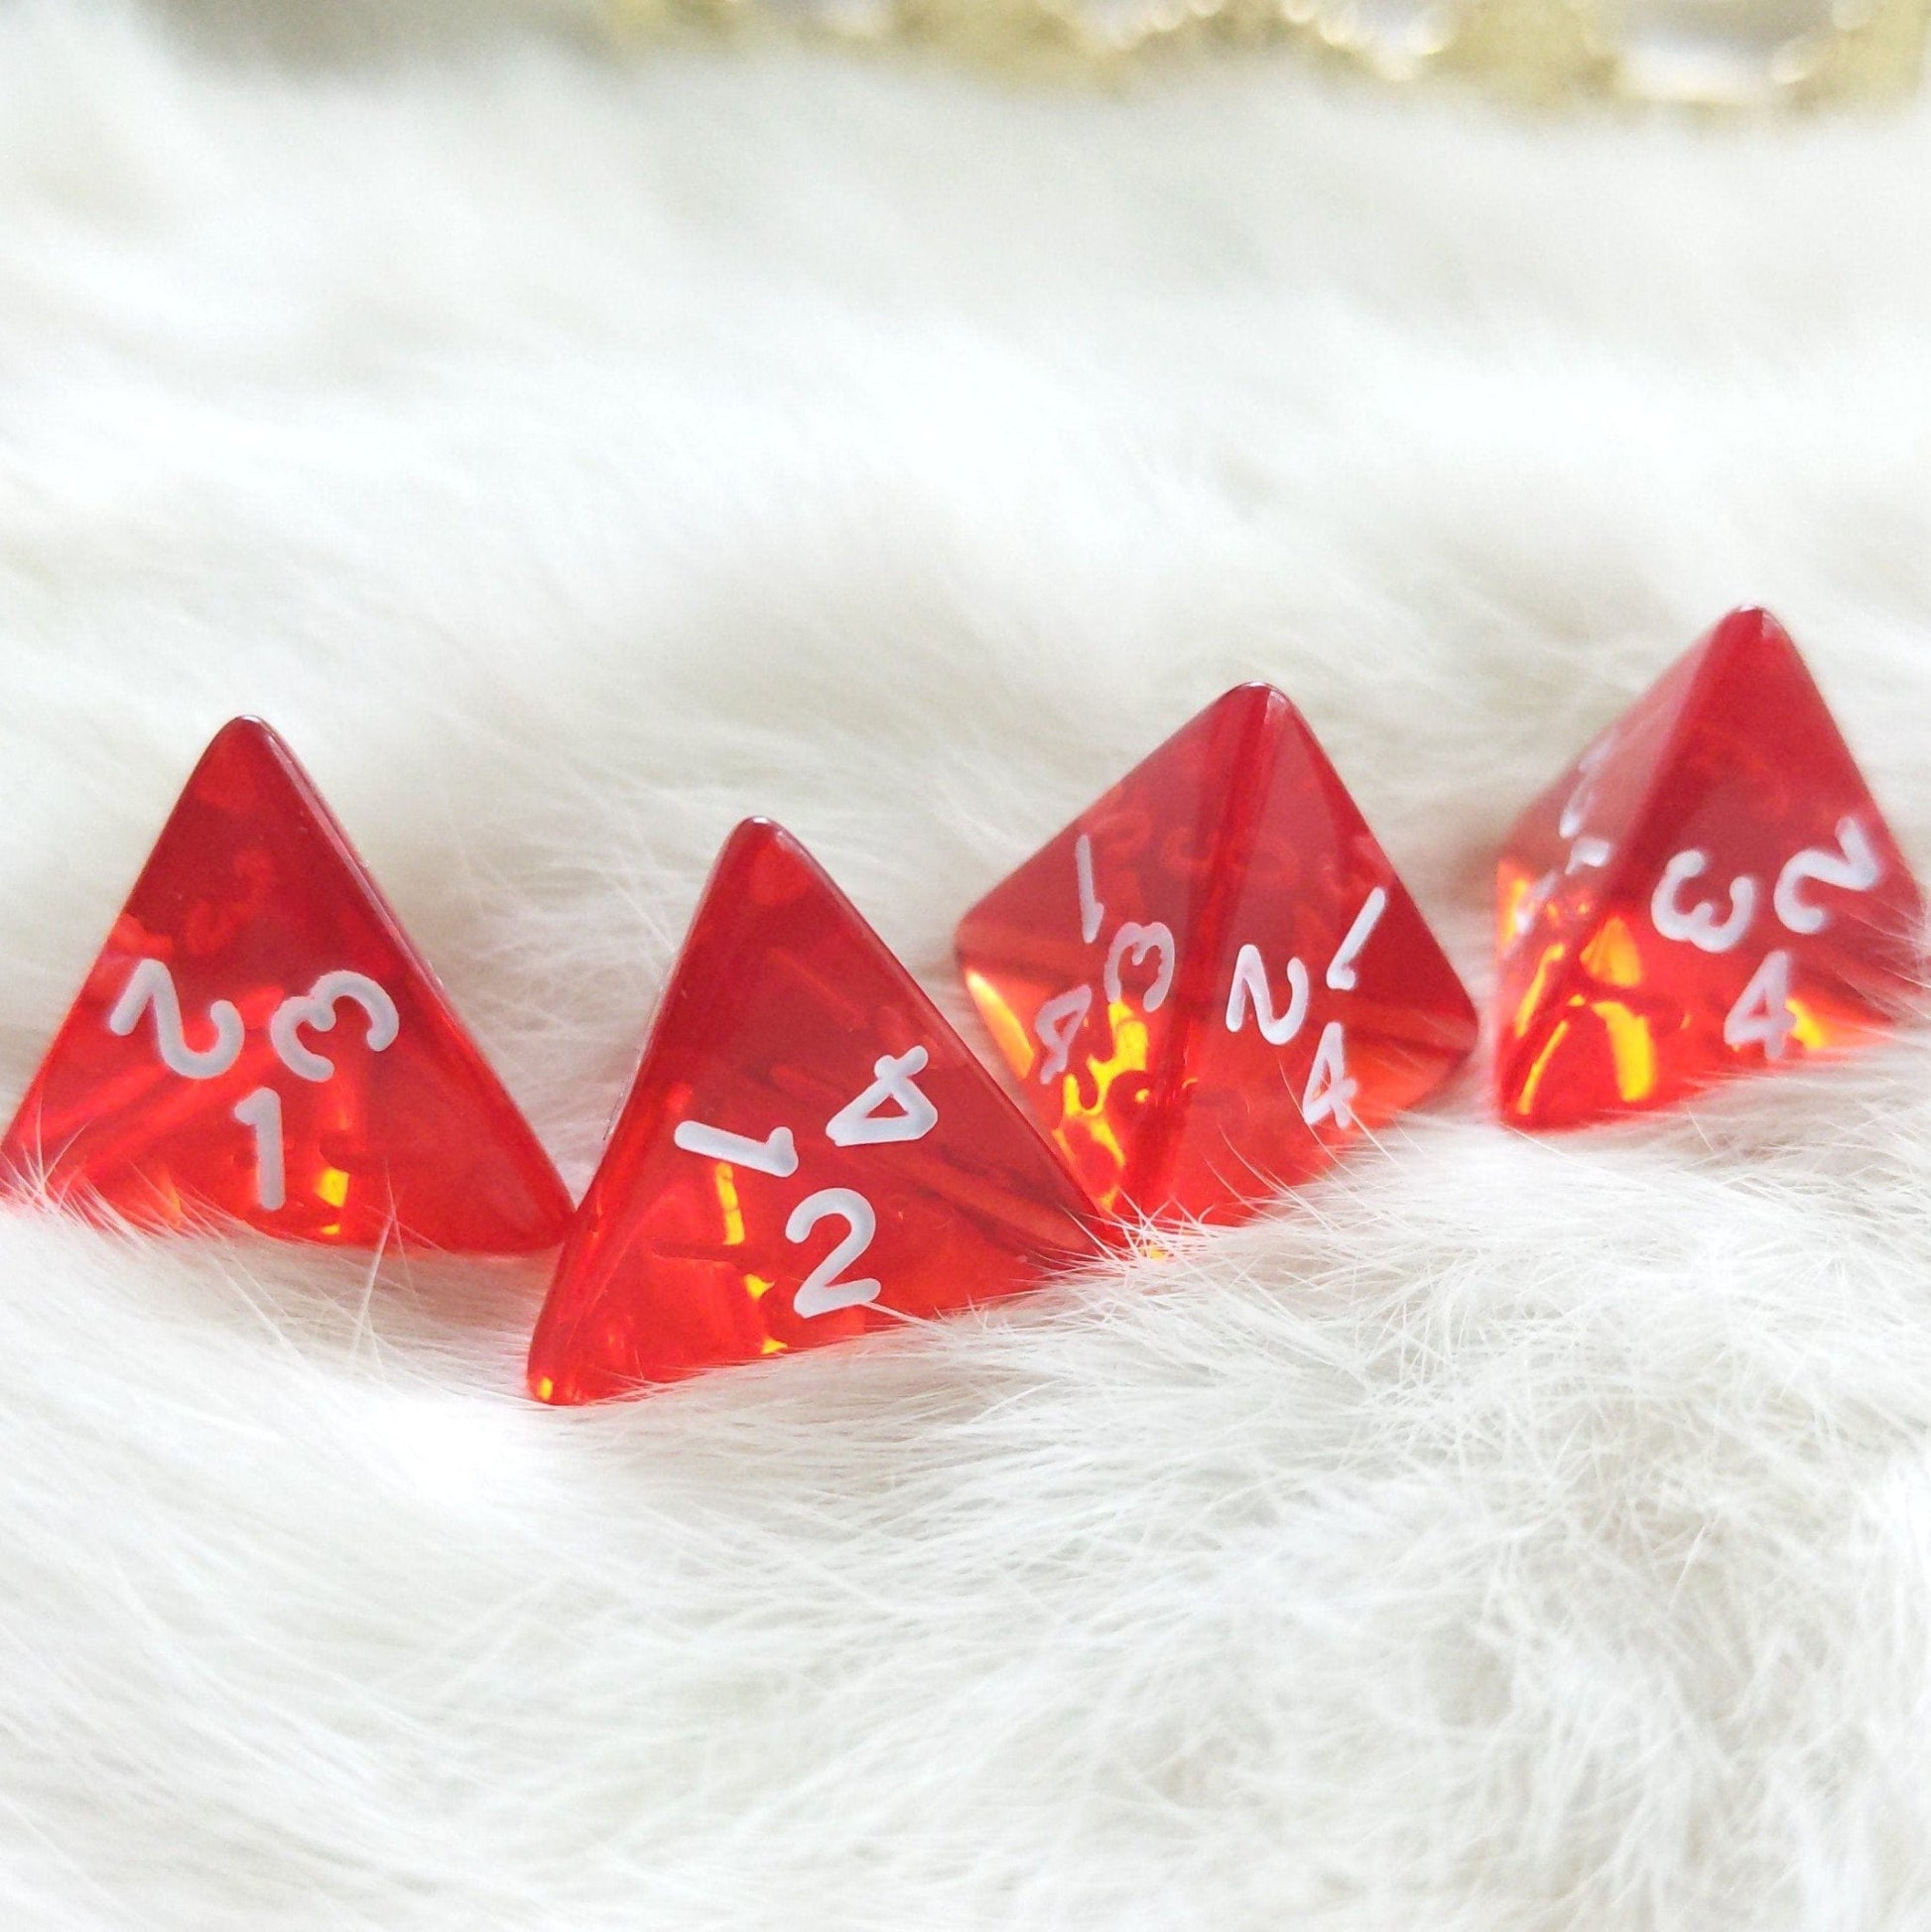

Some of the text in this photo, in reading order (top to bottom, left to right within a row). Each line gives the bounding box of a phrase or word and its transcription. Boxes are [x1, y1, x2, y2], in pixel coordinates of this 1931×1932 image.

[1075, 835, 1104, 944] 1
[1650, 848, 1755, 954] 3
[1773, 817, 1879, 935] 2
[1103, 922, 1175, 1012] 3
[1326, 886, 1386, 990] 1
[108, 959, 244, 1080] 2
[270, 969, 399, 1082] 3
[1034, 984, 1092, 1085] 4
[1225, 944, 1309, 1045] 2
[1724, 949, 1797, 1060] 4
[826, 1045, 939, 1146] 4
[1303, 1021, 1358, 1129] 4
[233, 1087, 285, 1211] 1
[674, 1119, 799, 1178] 1
[785, 1188, 881, 1318] 2
